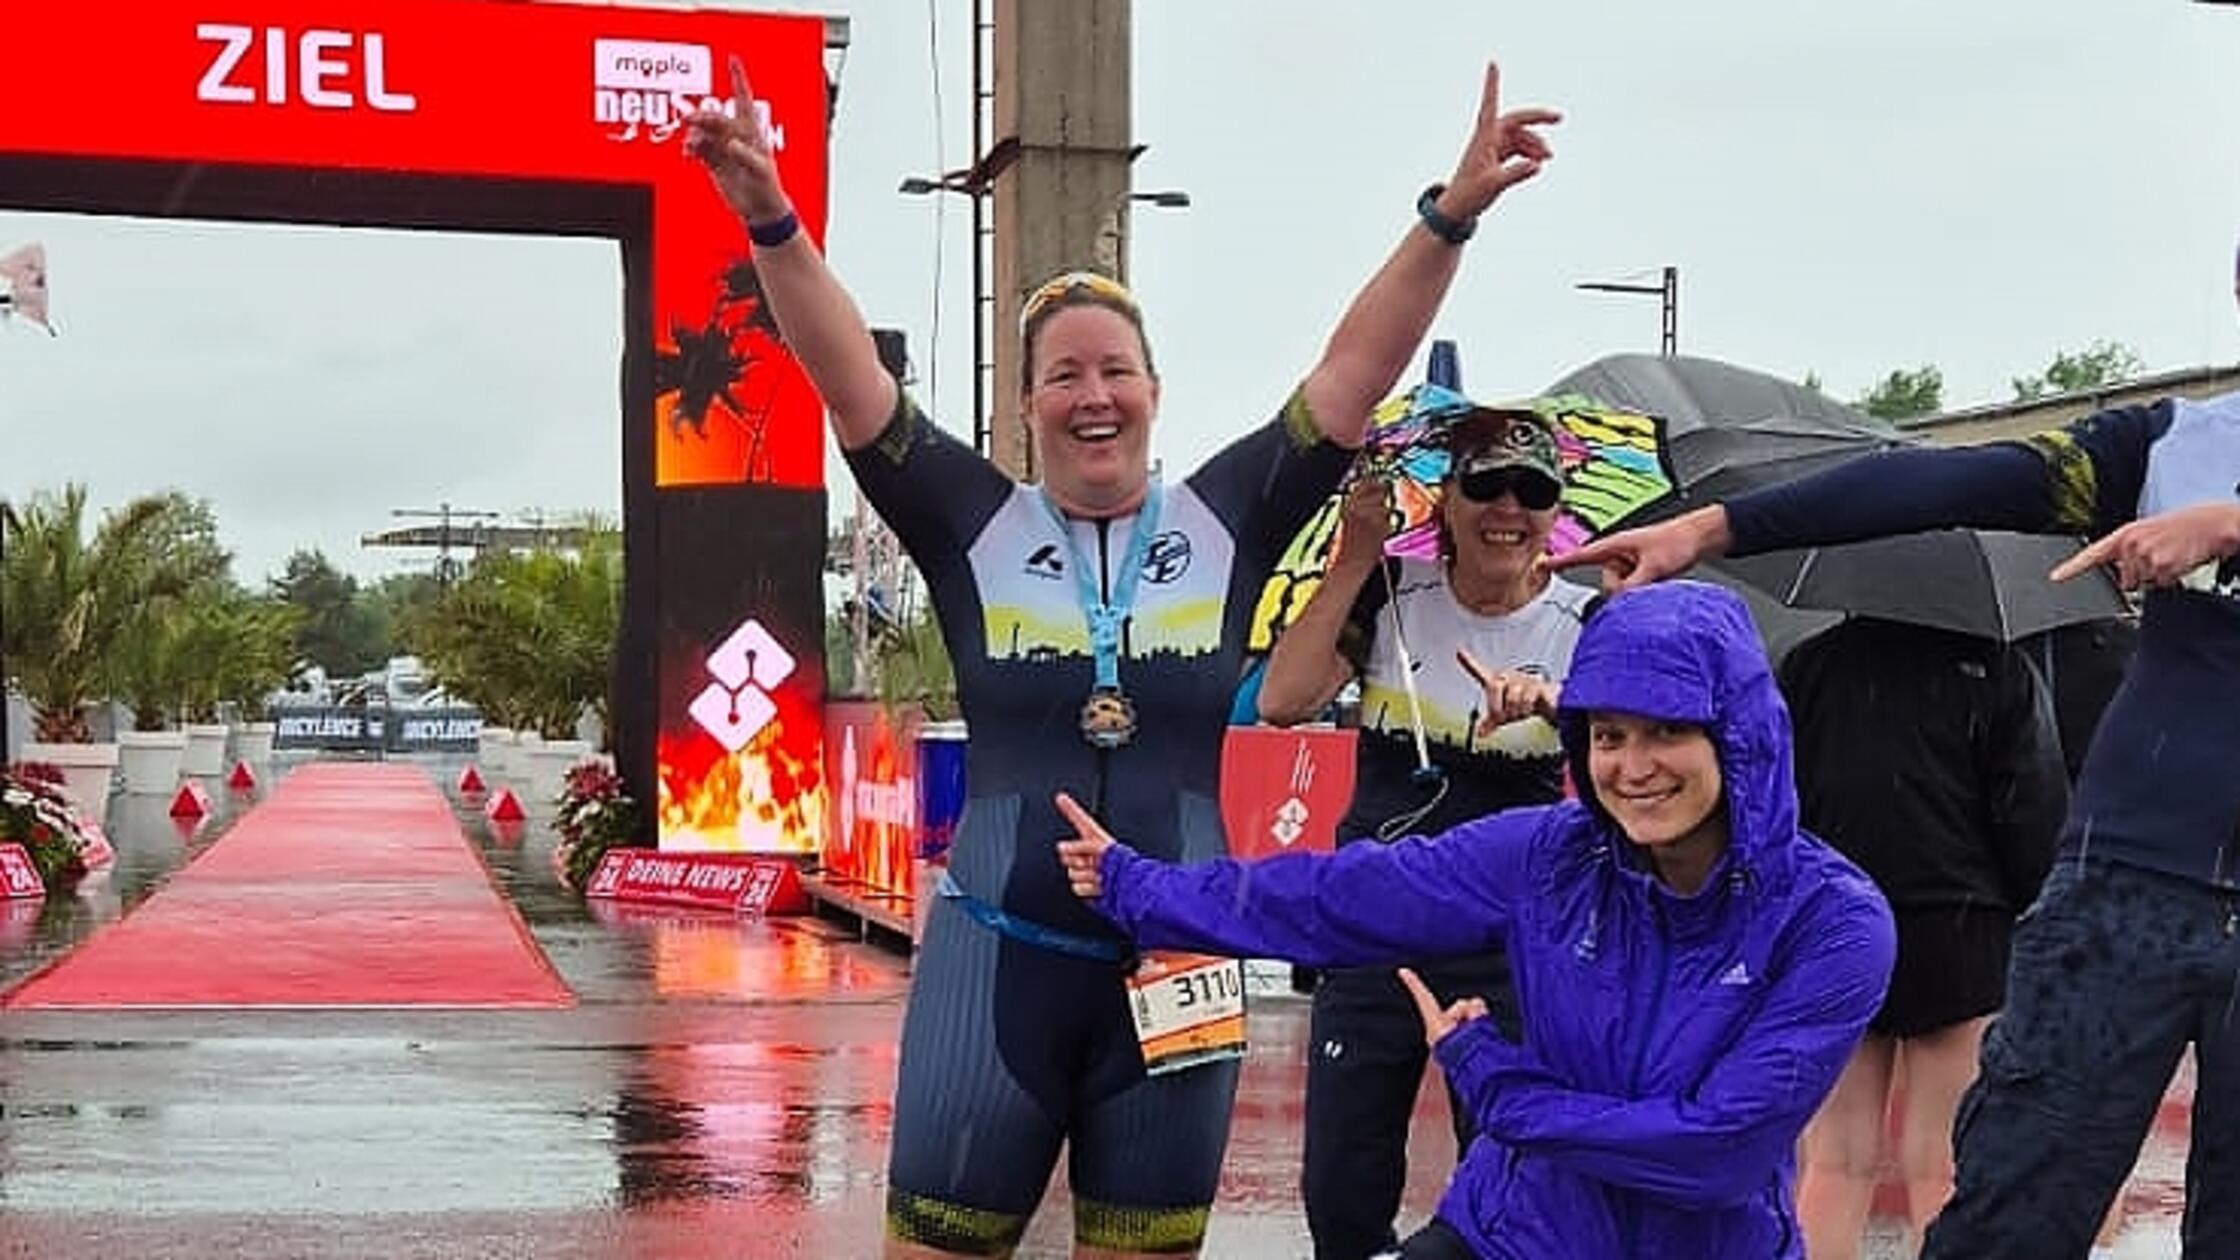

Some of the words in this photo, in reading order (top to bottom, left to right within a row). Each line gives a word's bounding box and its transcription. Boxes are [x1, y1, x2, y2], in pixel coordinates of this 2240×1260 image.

[196, 23, 417, 111] ZIEL
[615, 54, 692, 79] mopla
[627, 858, 688, 886] DEINE
[687, 864, 746, 891] NEWS
[1172, 967, 1239, 1007] 3110
